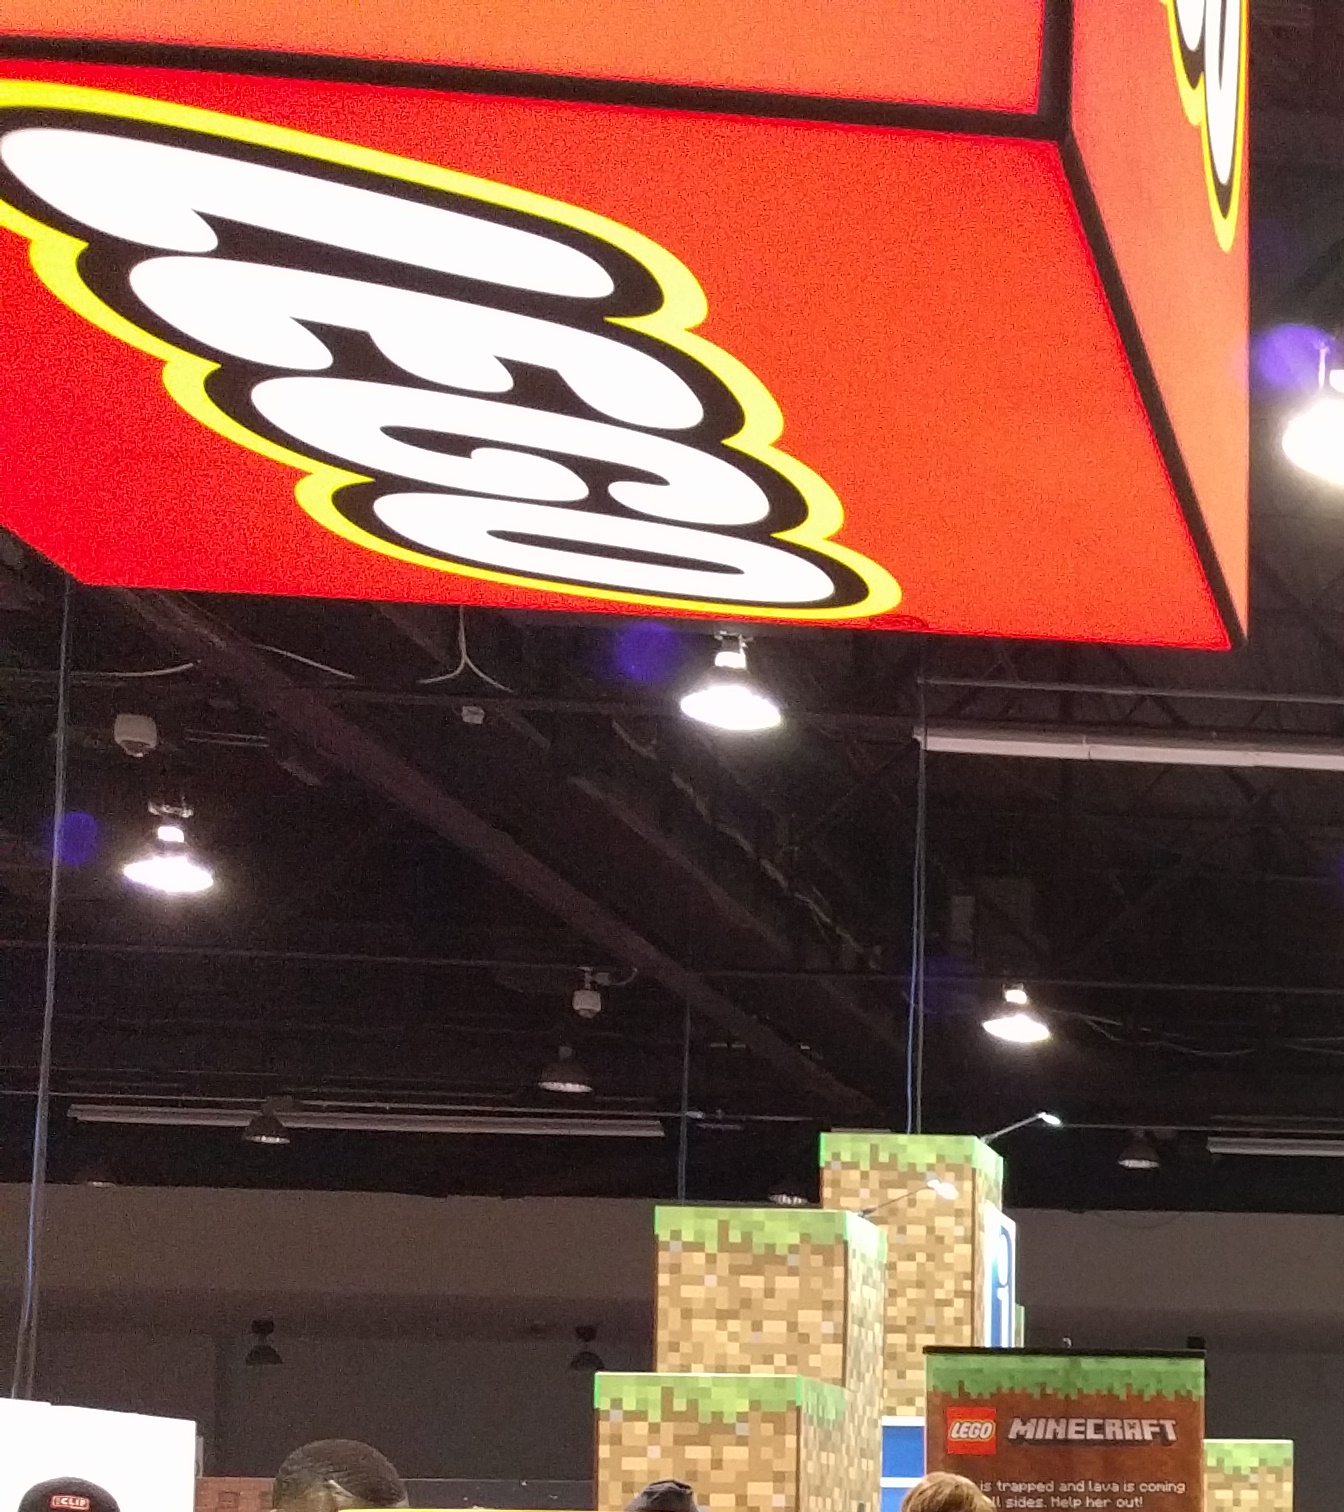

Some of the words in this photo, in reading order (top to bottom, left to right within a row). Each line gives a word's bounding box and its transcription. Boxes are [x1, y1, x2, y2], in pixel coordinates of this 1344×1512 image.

[0, 126, 838, 604] LEGO
[950, 1421, 994, 1440] LEGO
[1008, 1417, 1178, 1444] MINECRAFT
[980, 1480, 992, 1492] is
[996, 1480, 1055, 1494] trapped
[1059, 1480, 1085, 1492] and
[1088, 1480, 1120, 1493] lava
[1123, 1480, 1135, 1493] is
[1139, 1481, 1186, 1494] coming
[1005, 1496, 1048, 1509] sides.
[1050, 1496, 1082, 1509] Help
[1085, 1496, 1112, 1508] her
[1116, 1496, 1143, 1508] out!
